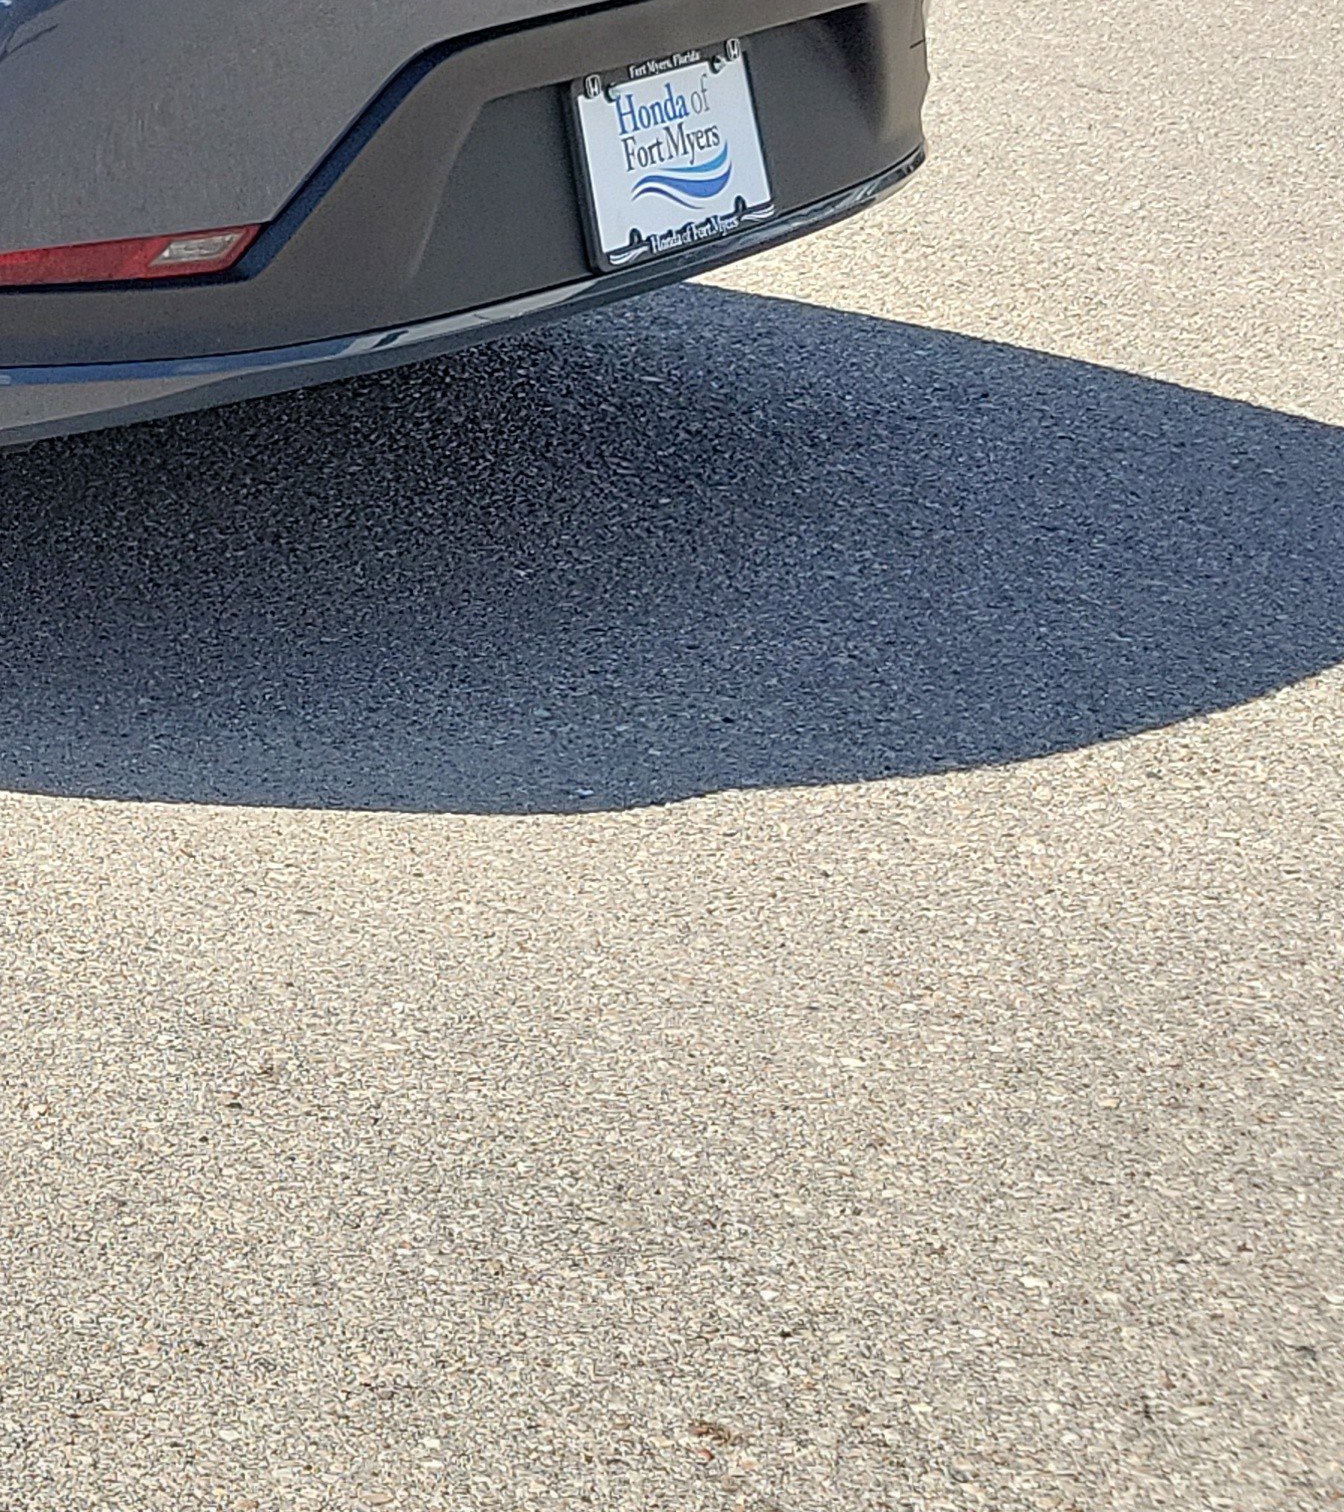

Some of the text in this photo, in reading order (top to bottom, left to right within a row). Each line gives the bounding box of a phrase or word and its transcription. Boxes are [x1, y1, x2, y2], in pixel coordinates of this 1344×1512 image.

[673, 50, 701, 67] Florida
[615, 73, 710, 136] Honda of
[621, 122, 721, 172] Fort Myers
[650, 229, 683, 254] Honda
